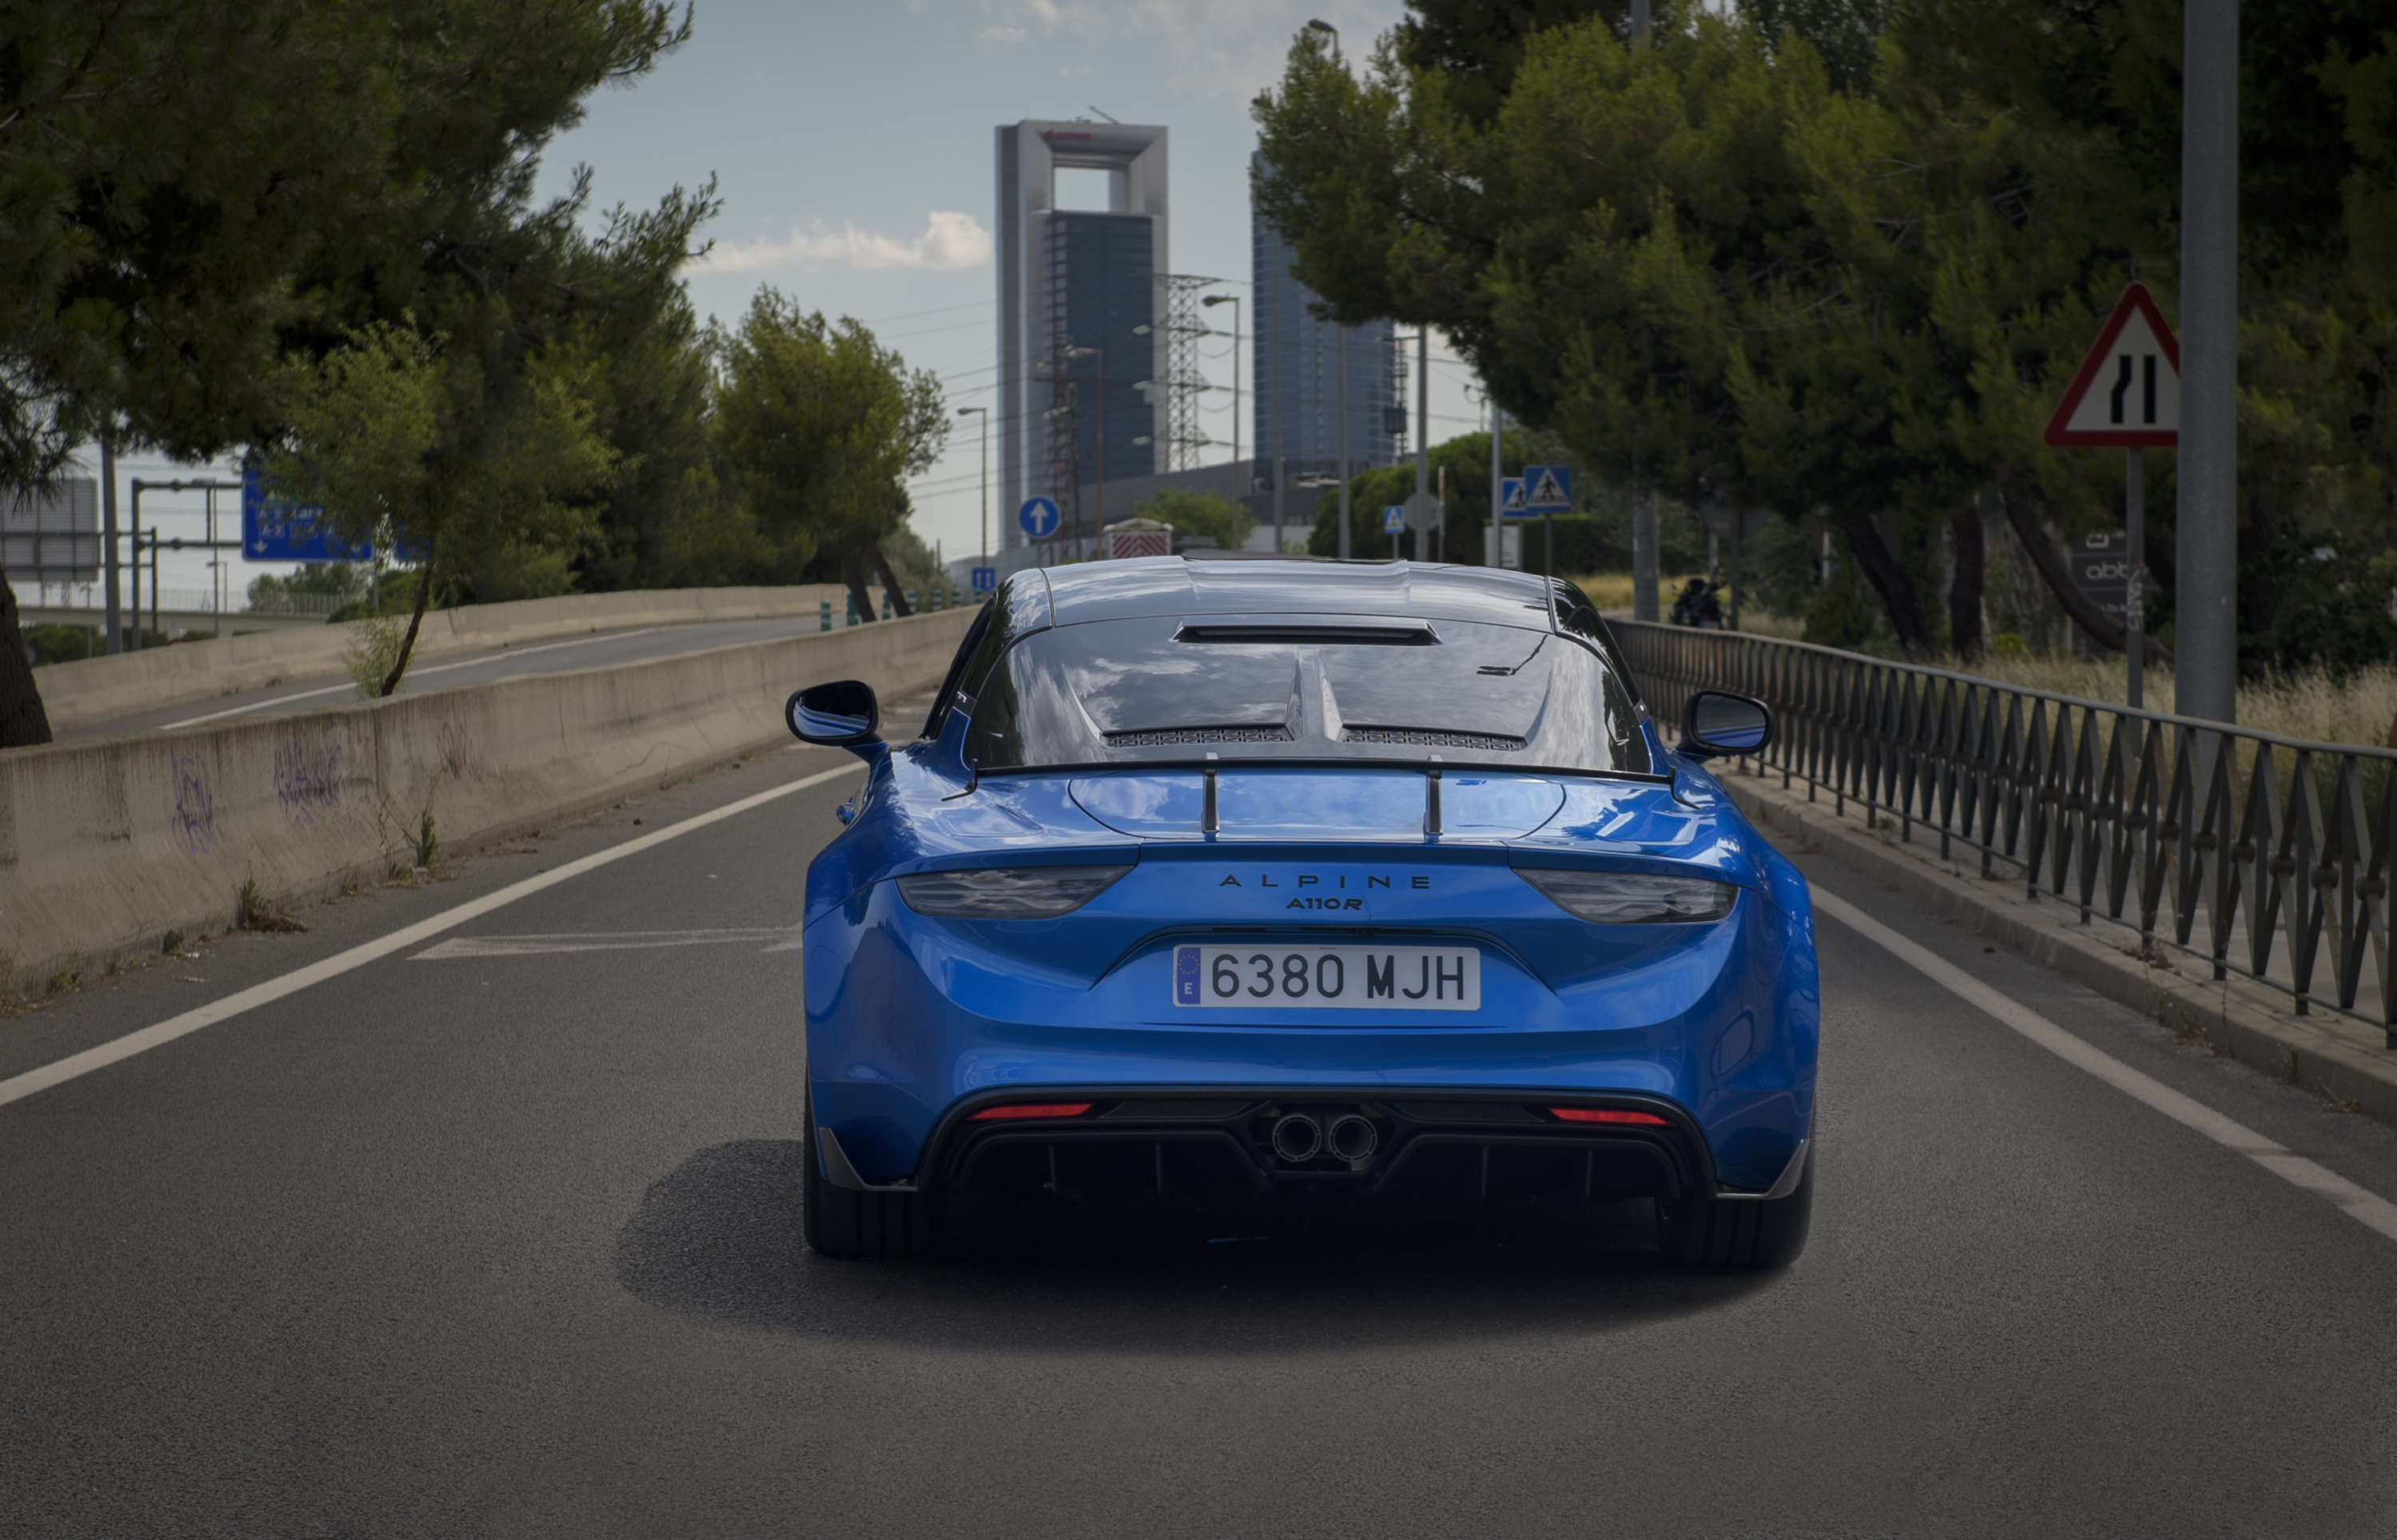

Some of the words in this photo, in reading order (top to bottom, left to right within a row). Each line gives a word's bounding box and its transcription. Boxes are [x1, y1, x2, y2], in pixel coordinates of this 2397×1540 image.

[1218, 874, 1430, 889] ALPINE
[1285, 897, 1364, 911] A110R
[1211, 953, 1344, 998] 6380
[1366, 955, 1464, 1000] MJH
[1184, 982, 1194, 995] E
